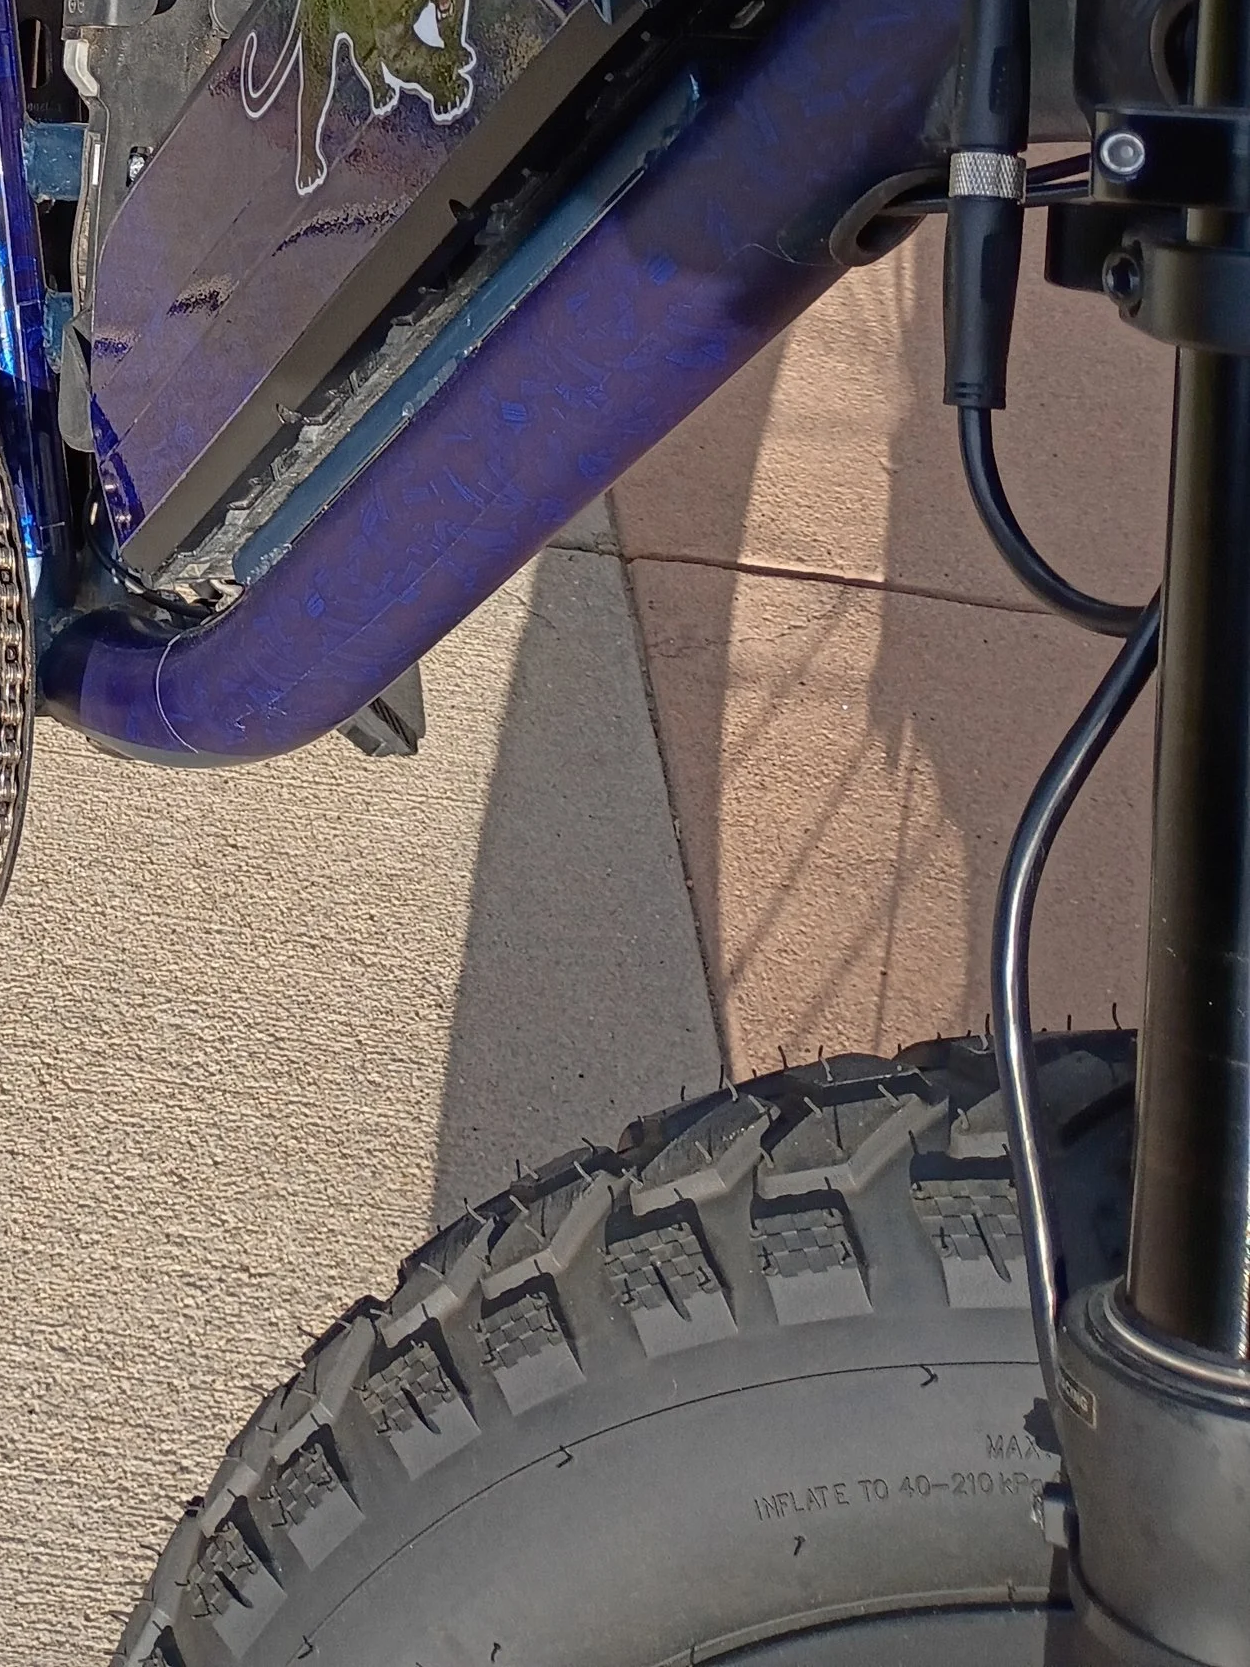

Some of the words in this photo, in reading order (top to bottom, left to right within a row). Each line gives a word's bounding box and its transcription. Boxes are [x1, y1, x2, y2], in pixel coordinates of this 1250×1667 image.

[754, 1482, 850, 1522] INFLATE
[858, 1478, 890, 1503] TO
[898, 1470, 994, 1502] 40-210
